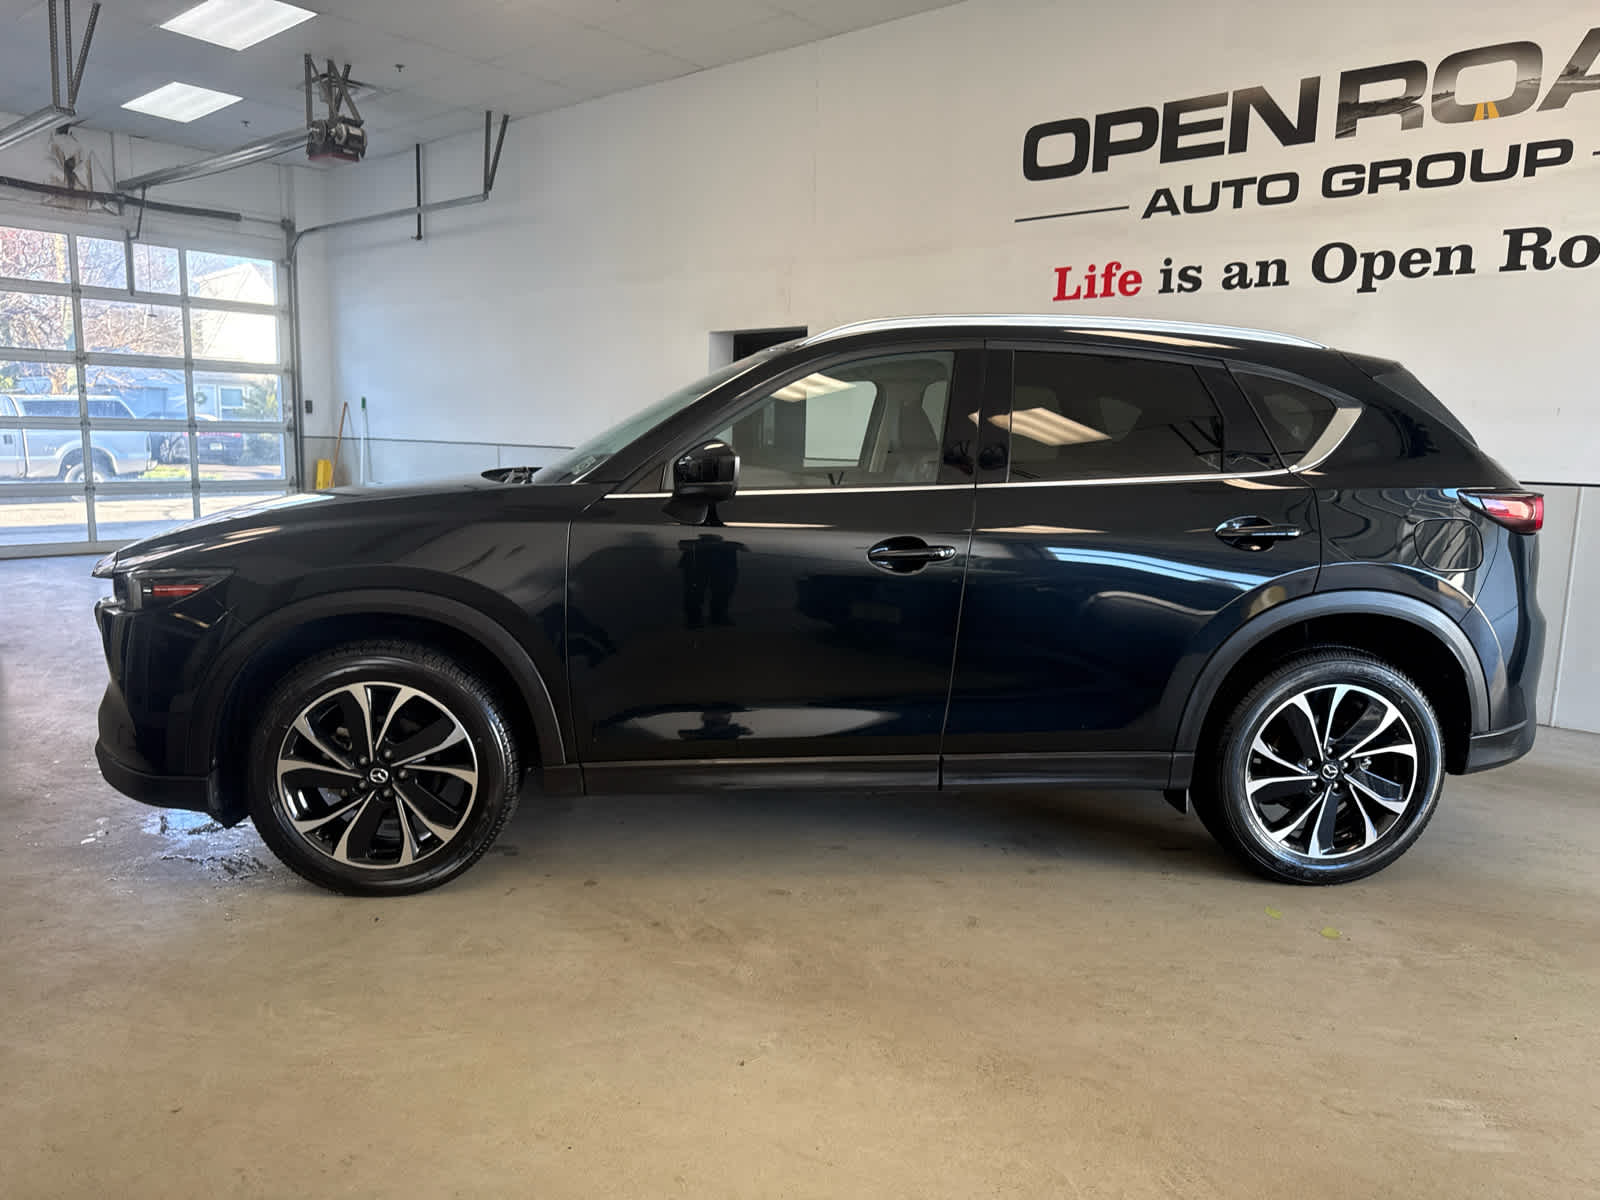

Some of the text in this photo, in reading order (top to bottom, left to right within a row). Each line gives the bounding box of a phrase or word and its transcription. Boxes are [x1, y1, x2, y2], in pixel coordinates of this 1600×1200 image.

[1140, 138, 1574, 220] AUTO GROUP
[1052, 226, 1600, 302] Life is an Open Ro
